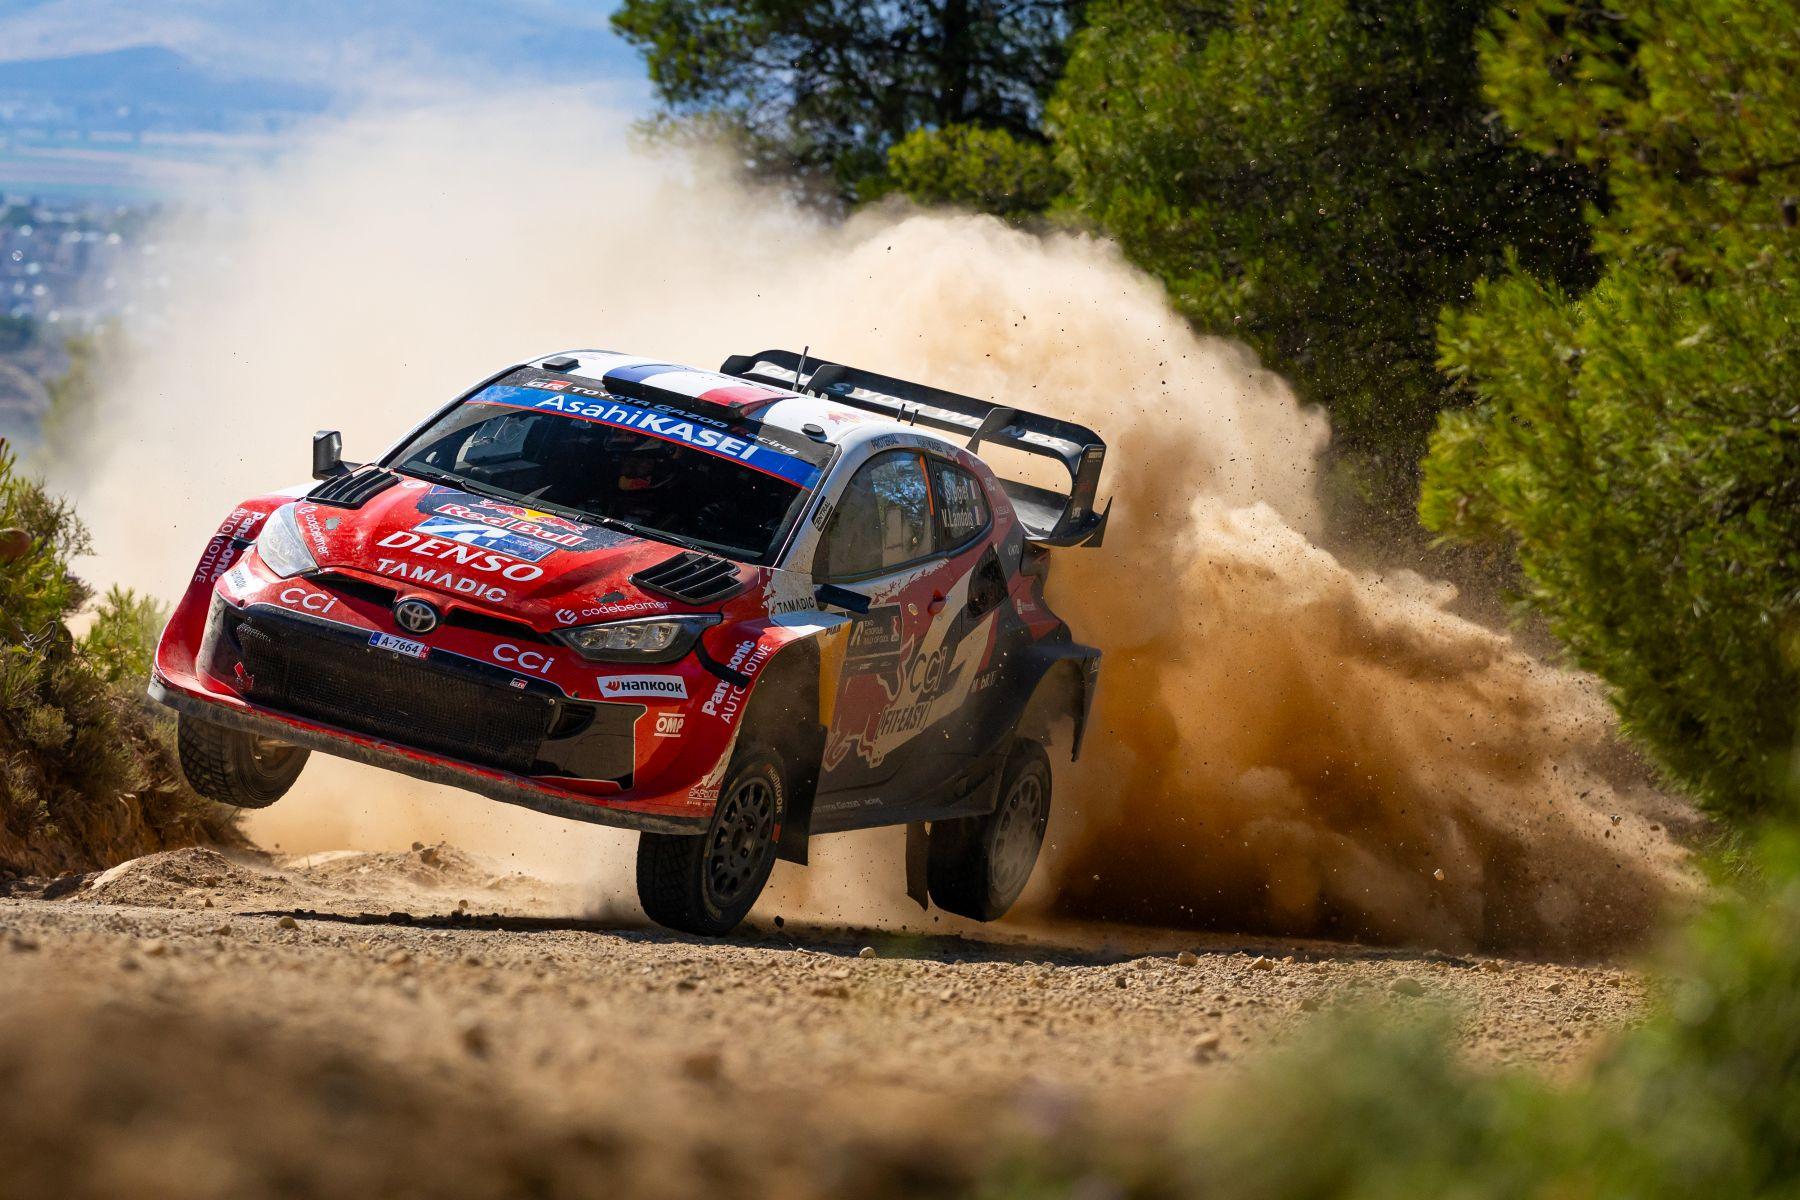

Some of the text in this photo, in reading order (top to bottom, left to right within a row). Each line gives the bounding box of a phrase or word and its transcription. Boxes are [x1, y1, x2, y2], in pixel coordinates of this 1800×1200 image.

[523, 377, 573, 391] GR
[571, 386, 652, 408] TOYOTA
[653, 404, 729, 429] GAZOO
[533, 394, 759, 461] AsahiKASEI
[433, 503, 592, 548] Red Bull
[375, 531, 544, 582] DENSO
[376, 558, 507, 602] TAMADIC
[582, 600, 669, 618] codebeamer
[776, 597, 815, 615] TAMADIC
[381, 636, 420, 655] A-7664
[655, 717, 685, 733] OMP
